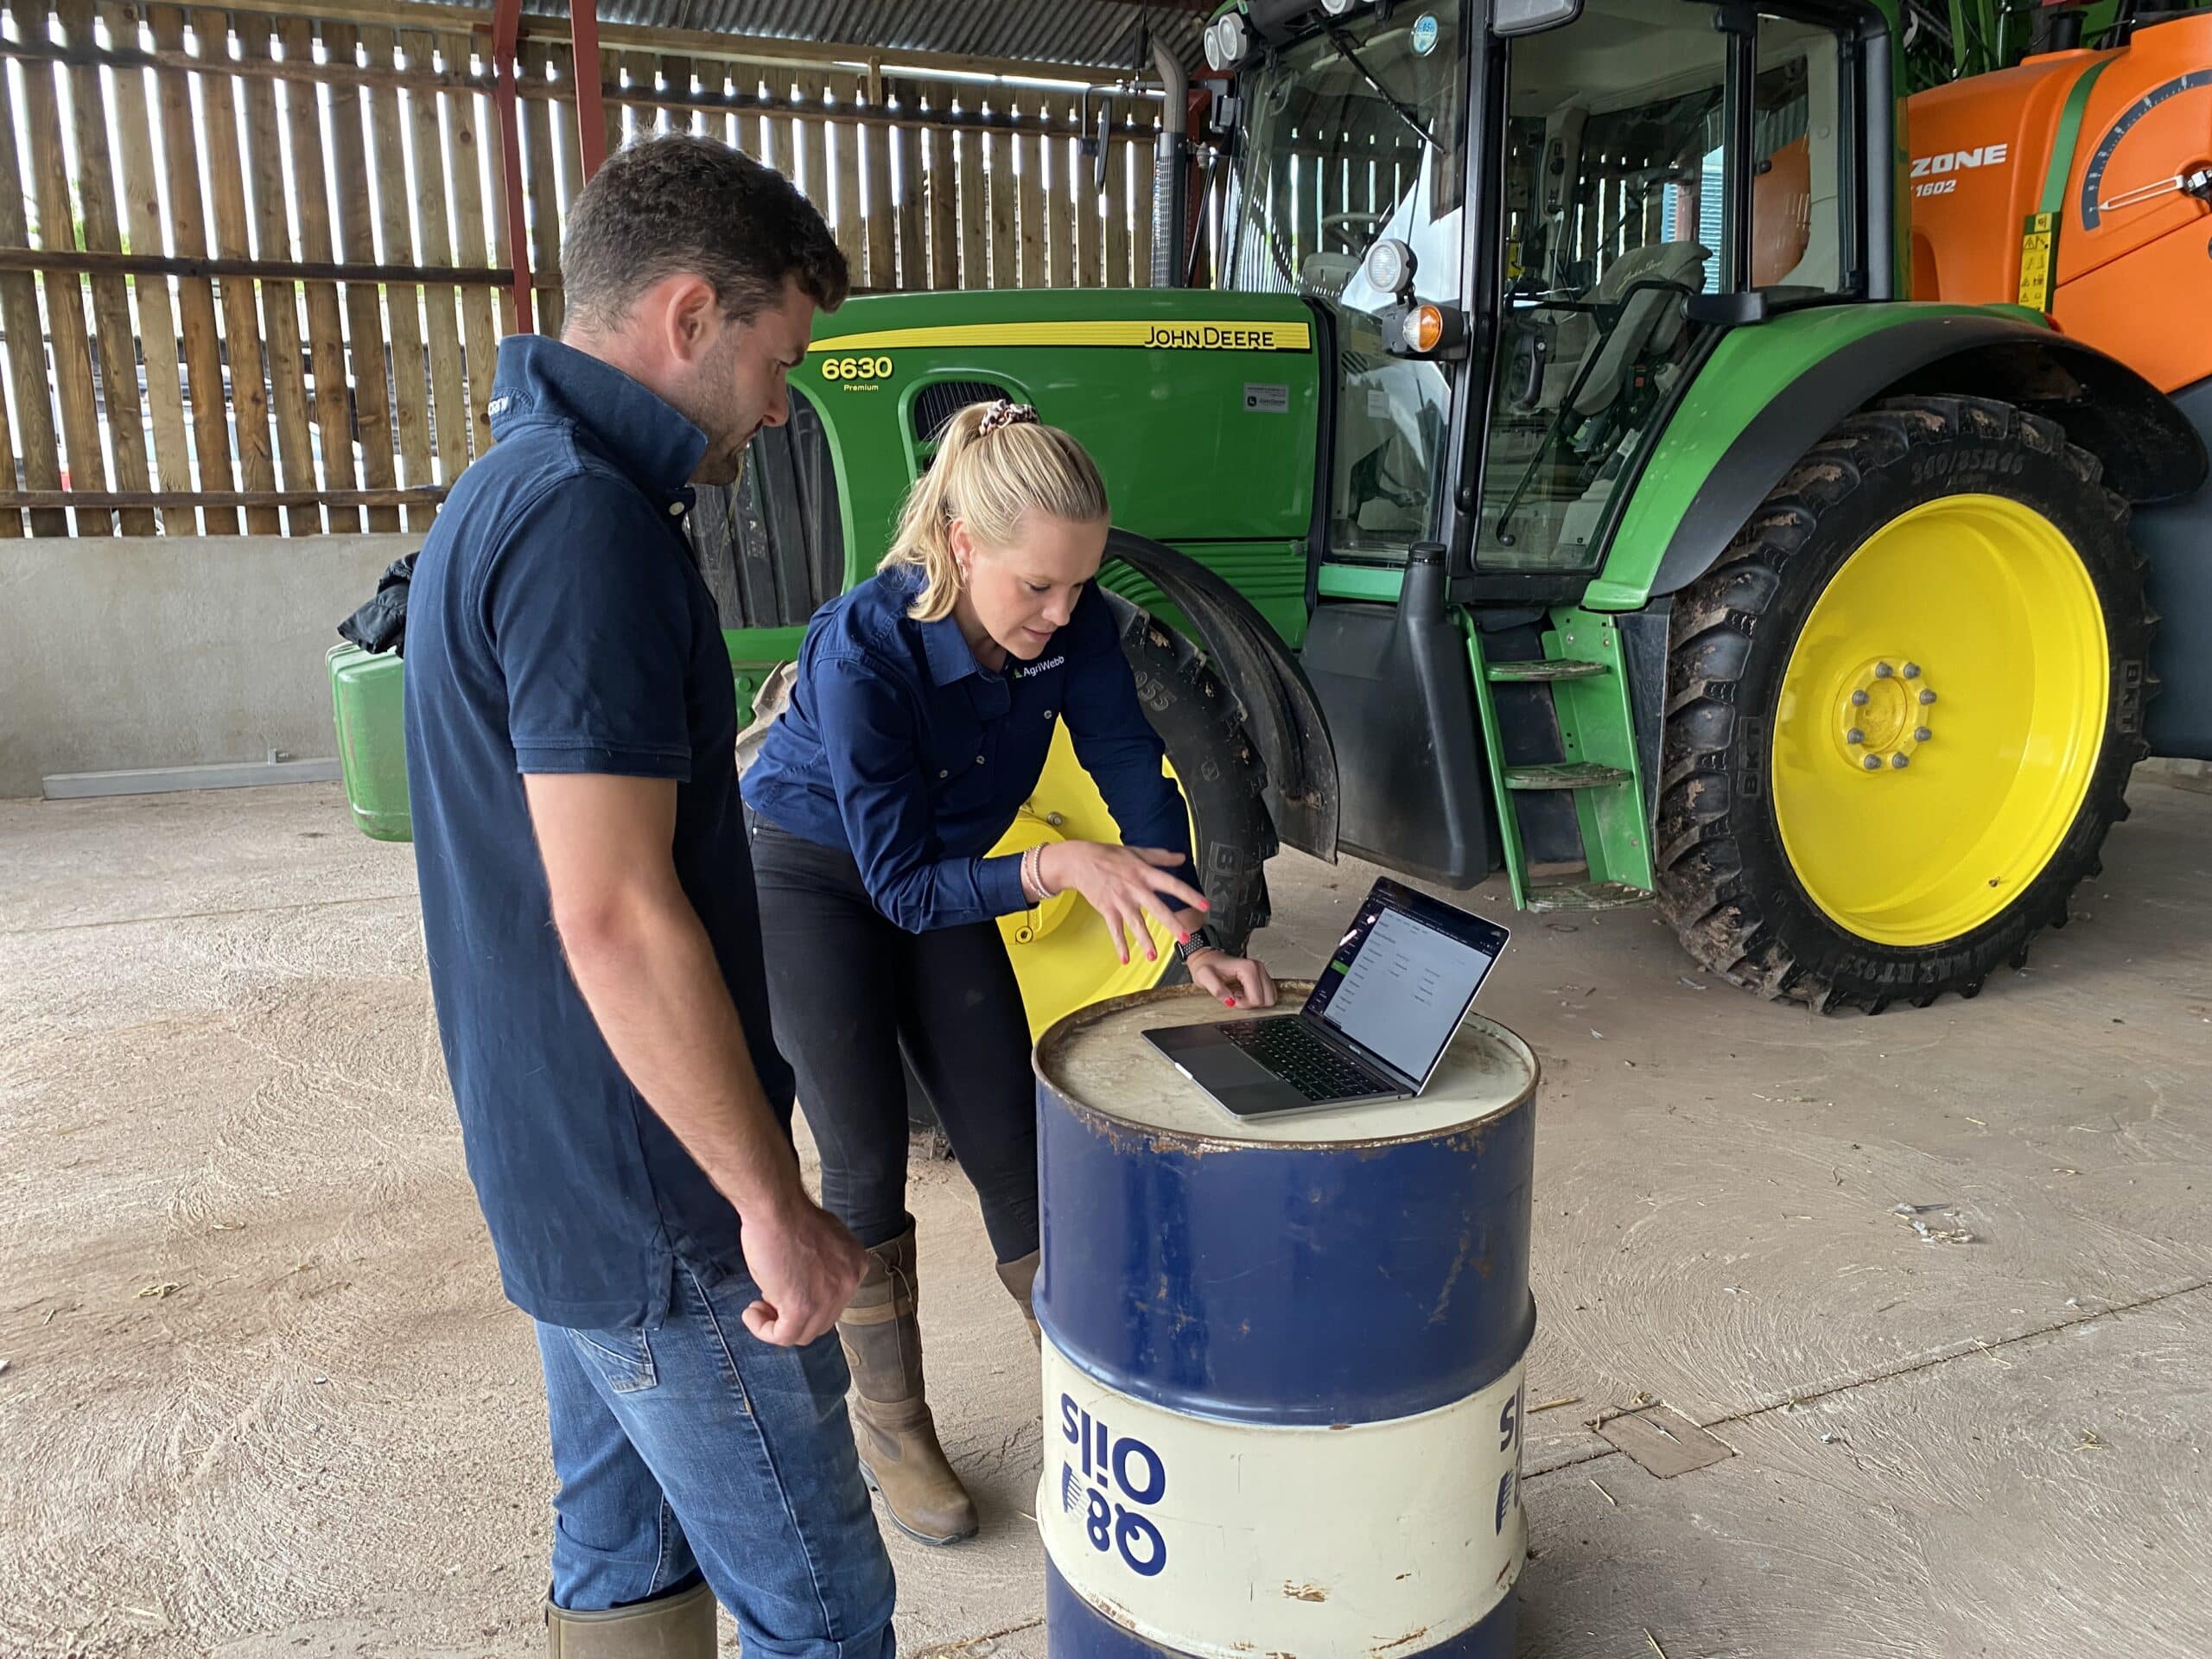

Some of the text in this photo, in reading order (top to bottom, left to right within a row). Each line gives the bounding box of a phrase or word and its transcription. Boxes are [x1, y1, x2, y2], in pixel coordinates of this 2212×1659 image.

[1916, 179, 1957, 198] 1602
[822, 356, 893, 380] 6630
[1023, 655, 1065, 677] AgriWebb
[1740, 719, 1760, 795] BKT
[1061, 1392, 1166, 1506] Oils
[1086, 1487, 1166, 1577] Q8
